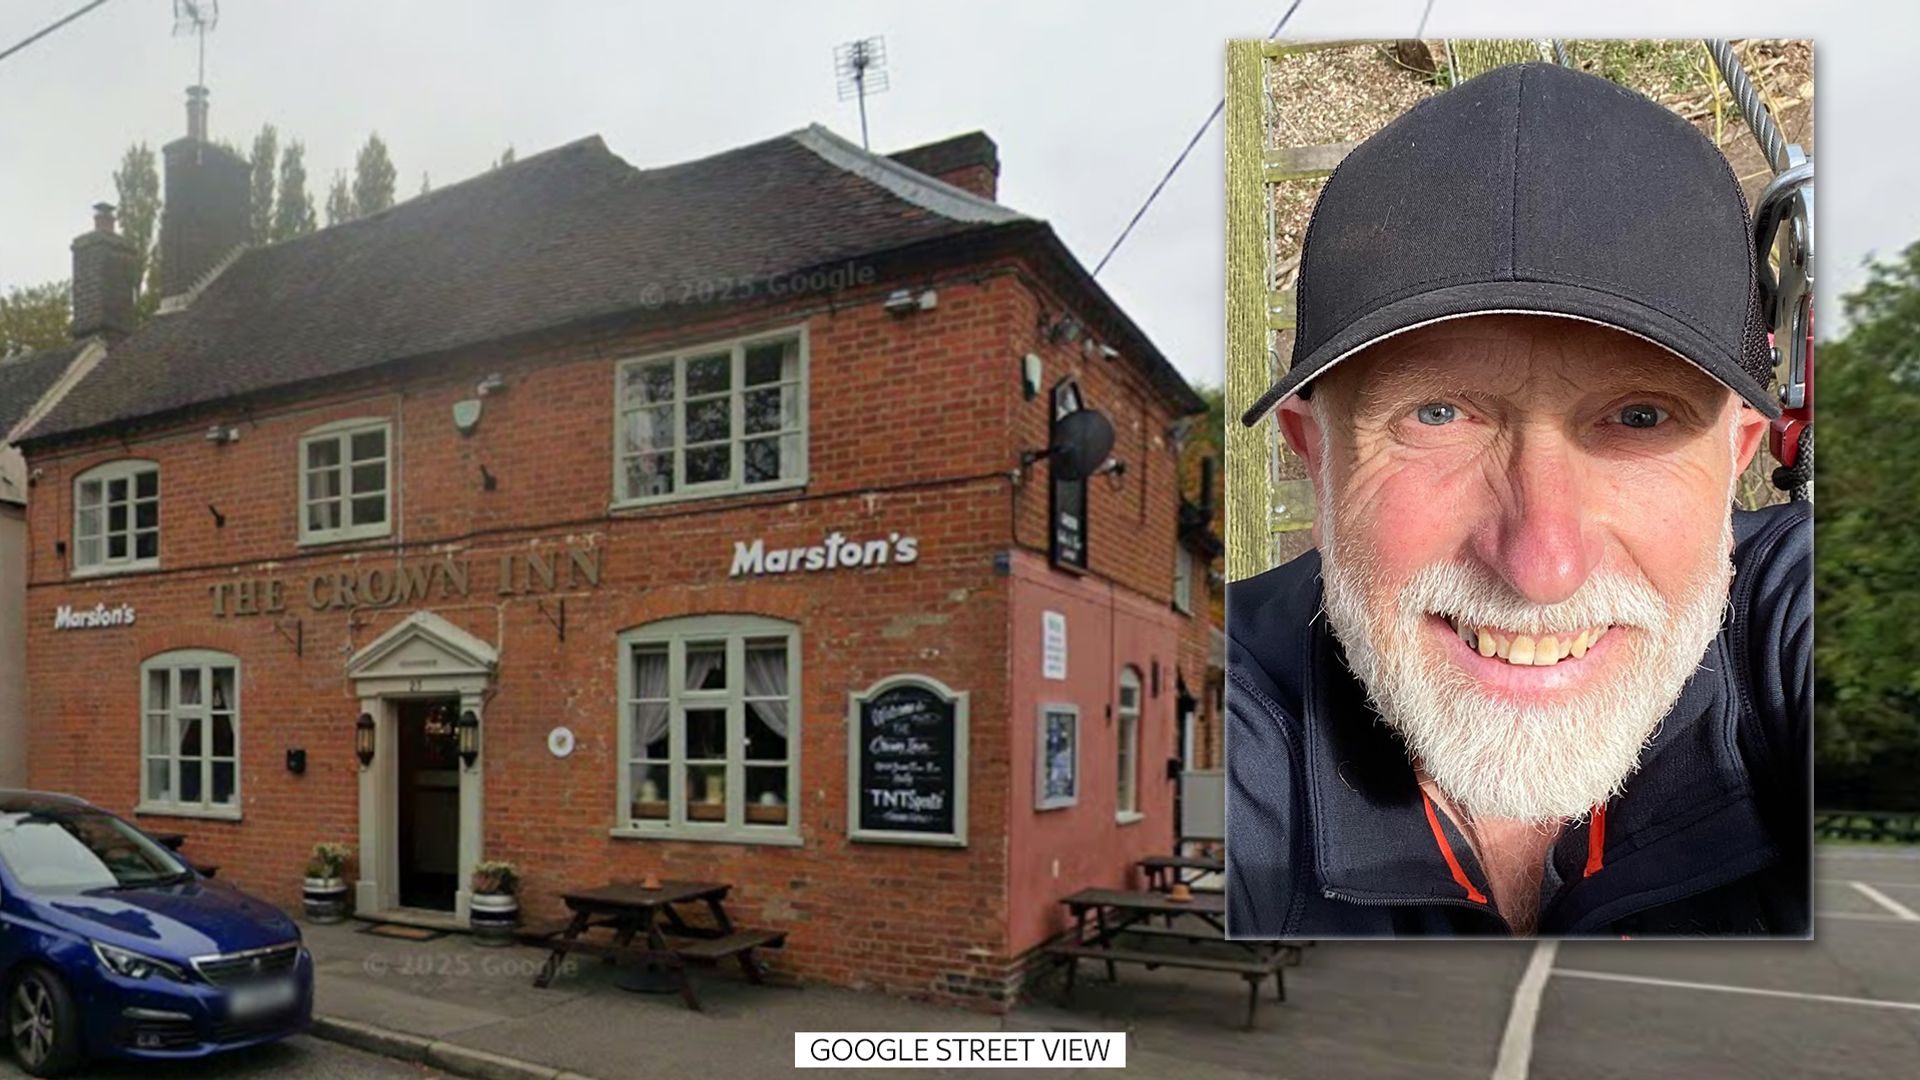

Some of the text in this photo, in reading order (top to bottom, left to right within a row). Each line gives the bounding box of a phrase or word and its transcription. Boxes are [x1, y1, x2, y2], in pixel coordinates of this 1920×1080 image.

[730, 531, 919, 577] Marston's
[209, 545, 602, 617] THE CROWN INN
[54, 602, 136, 630] Marston's
[870, 789, 909, 808] TNT
